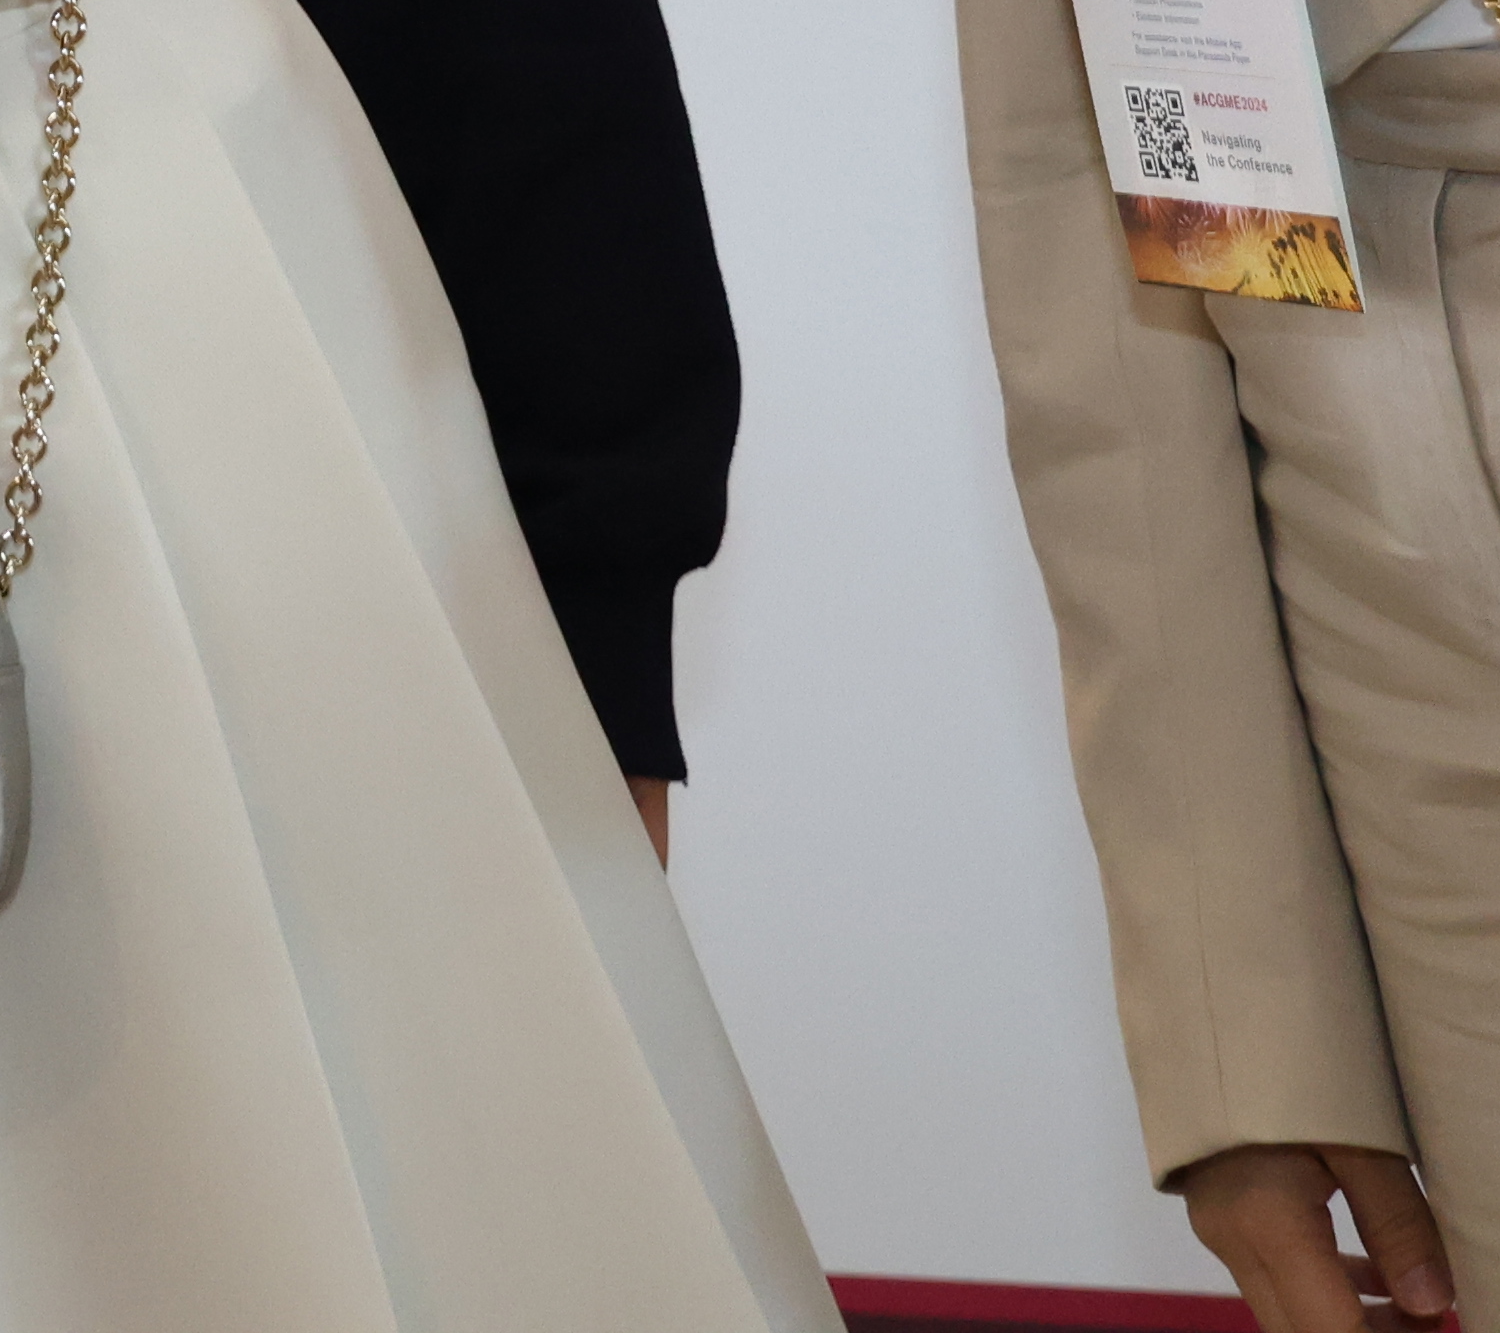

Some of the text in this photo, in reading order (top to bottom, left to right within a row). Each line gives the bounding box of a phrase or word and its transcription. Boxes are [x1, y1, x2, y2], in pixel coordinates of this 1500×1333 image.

[1193, 91, 1269, 112] #ACGME2024
[1201, 129, 1262, 153] Navigating
[1206, 153, 1294, 175] the Conference
